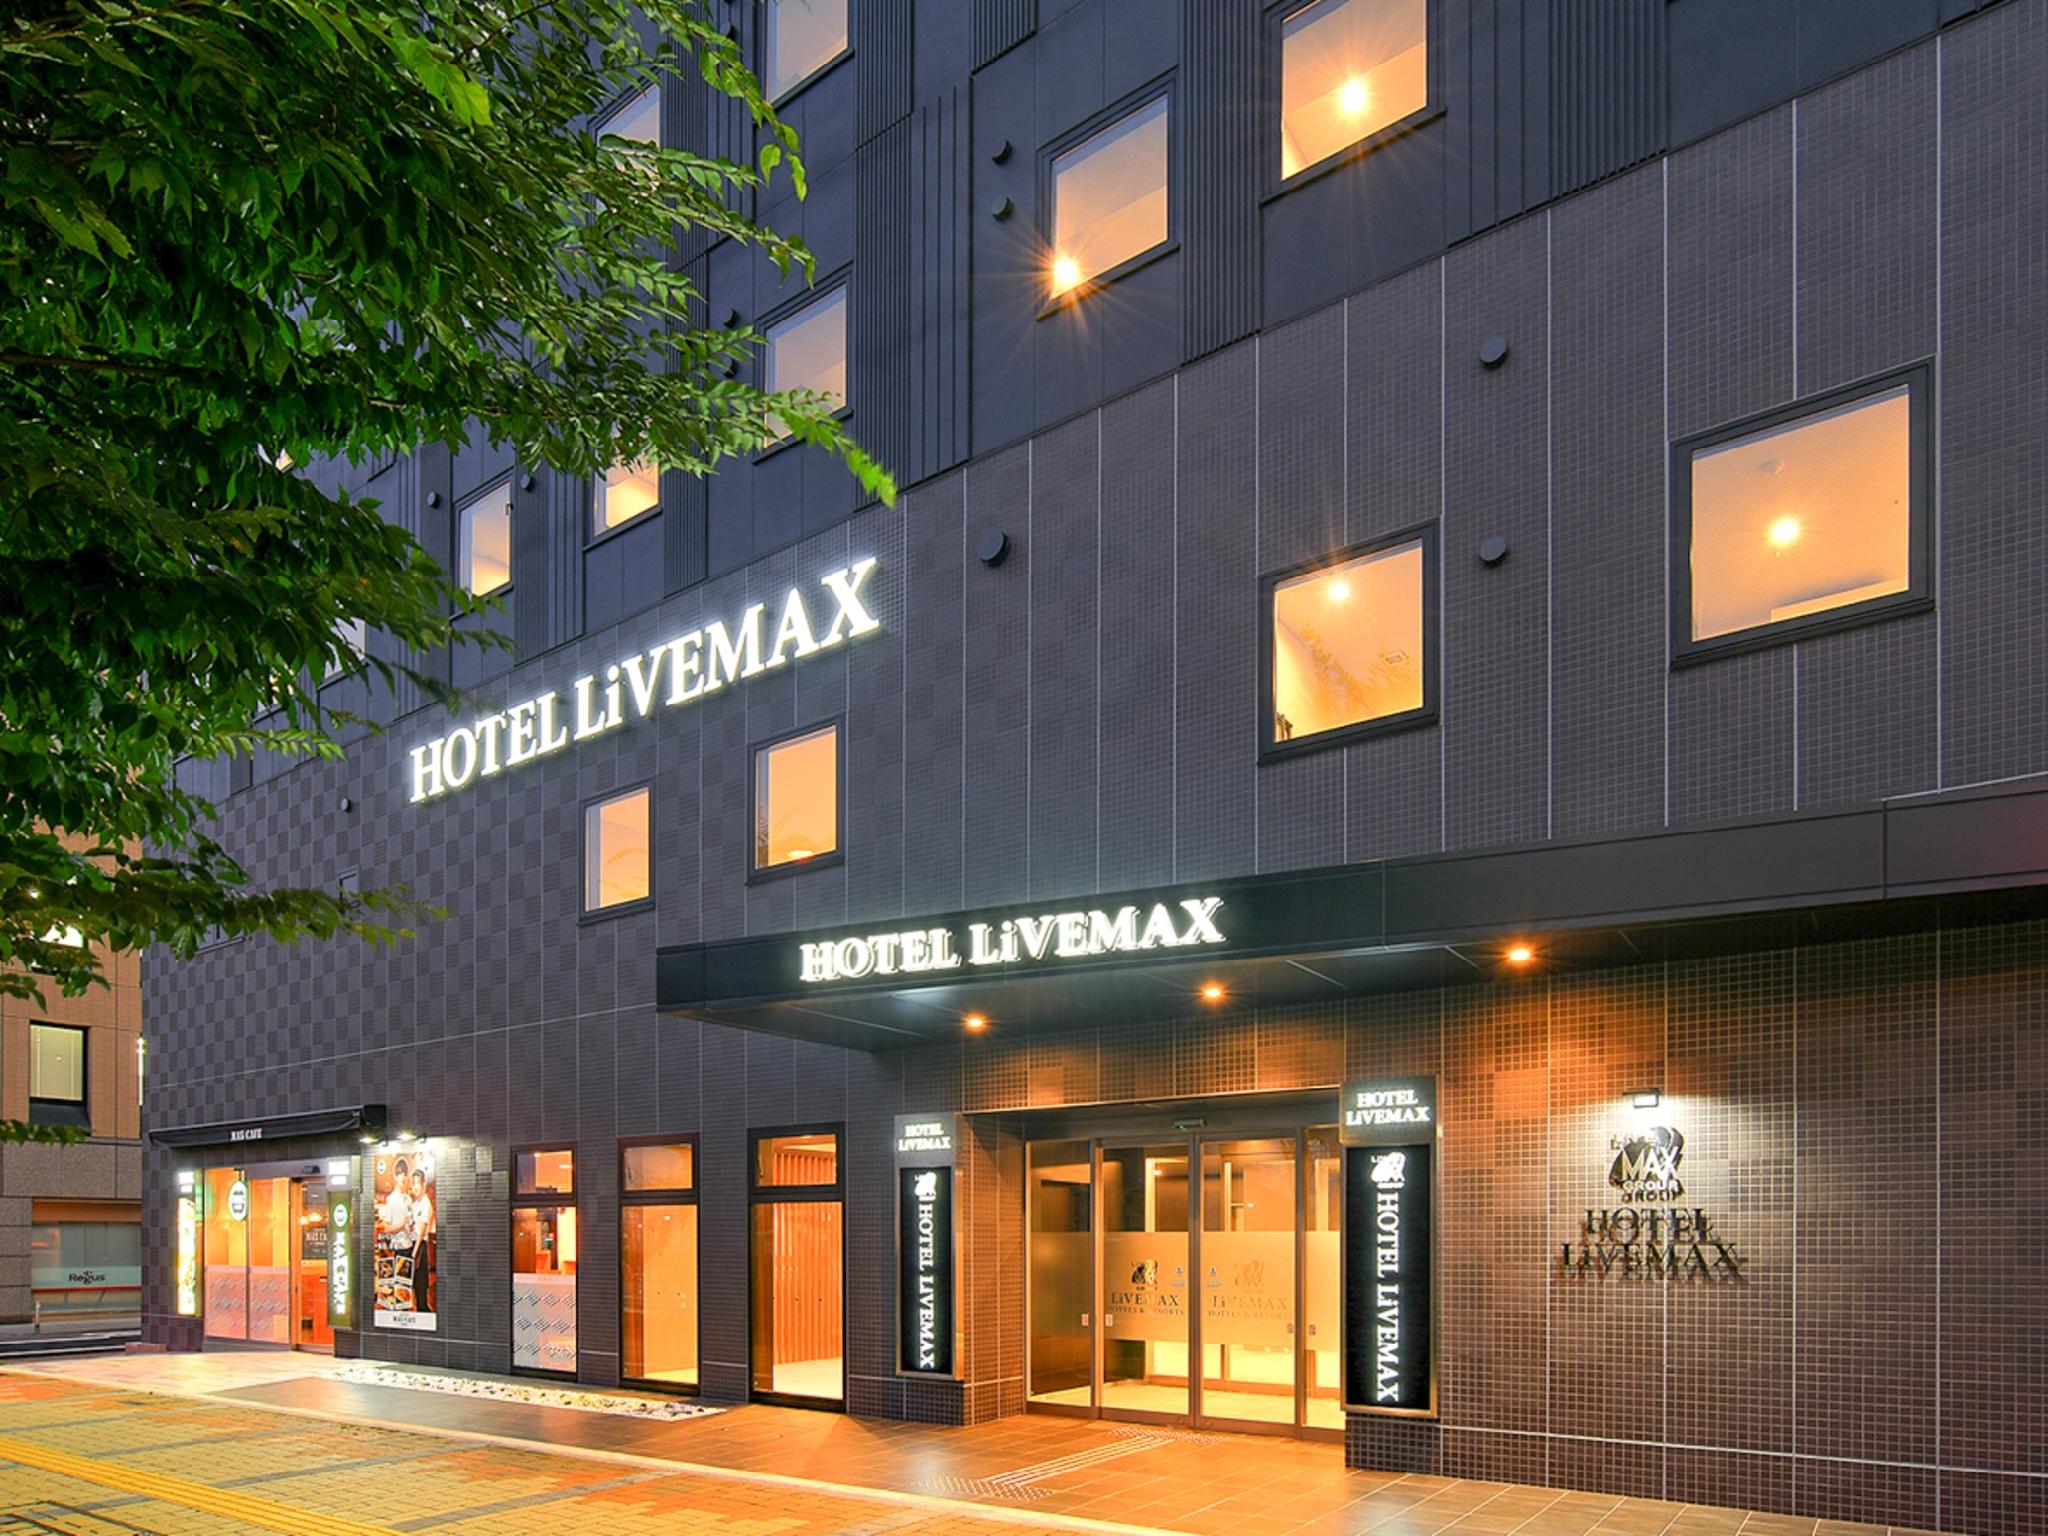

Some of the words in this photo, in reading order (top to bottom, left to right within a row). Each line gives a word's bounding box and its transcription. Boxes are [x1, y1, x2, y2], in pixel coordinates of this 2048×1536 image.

[408, 691, 570, 804] HOTEL
[573, 556, 880, 744] LiVEMAX
[799, 928, 960, 983] HOTEL
[968, 896, 1225, 966] LiVEMAX
[1357, 1090, 1419, 1108] HOTEL
[905, 1123, 944, 1137] HOTEL
[1620, 1145, 1681, 1181] MAX
[918, 1203, 934, 1271] HOTEL
[1377, 1192, 1399, 1278] HOTEL
[1585, 1207, 1715, 1234] HOTEL
[68, 1269, 106, 1286] Regus
